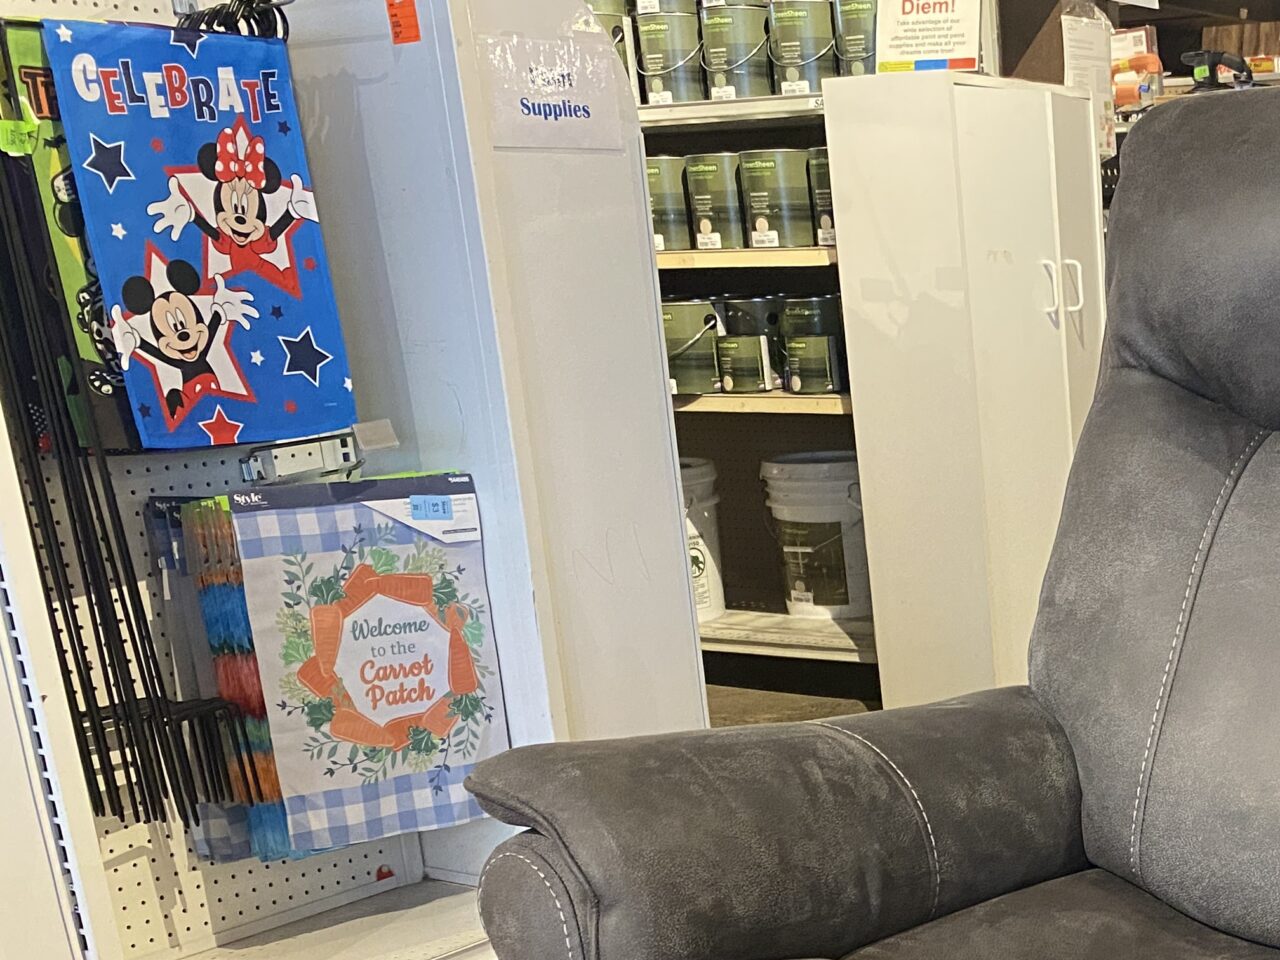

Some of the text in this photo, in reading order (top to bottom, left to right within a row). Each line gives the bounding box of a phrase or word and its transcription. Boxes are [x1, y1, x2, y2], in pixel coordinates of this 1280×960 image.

[902, 0, 955, 15] Diem!
[71, 53, 282, 123] CELEBRATE
[520, 97, 591, 121] Supplies
[233, 492, 262, 507] Style
[349, 616, 430, 641] Welcome
[371, 641, 416, 658] to the
[360, 653, 434, 685] Carrot
[365, 677, 435, 711] Patch
